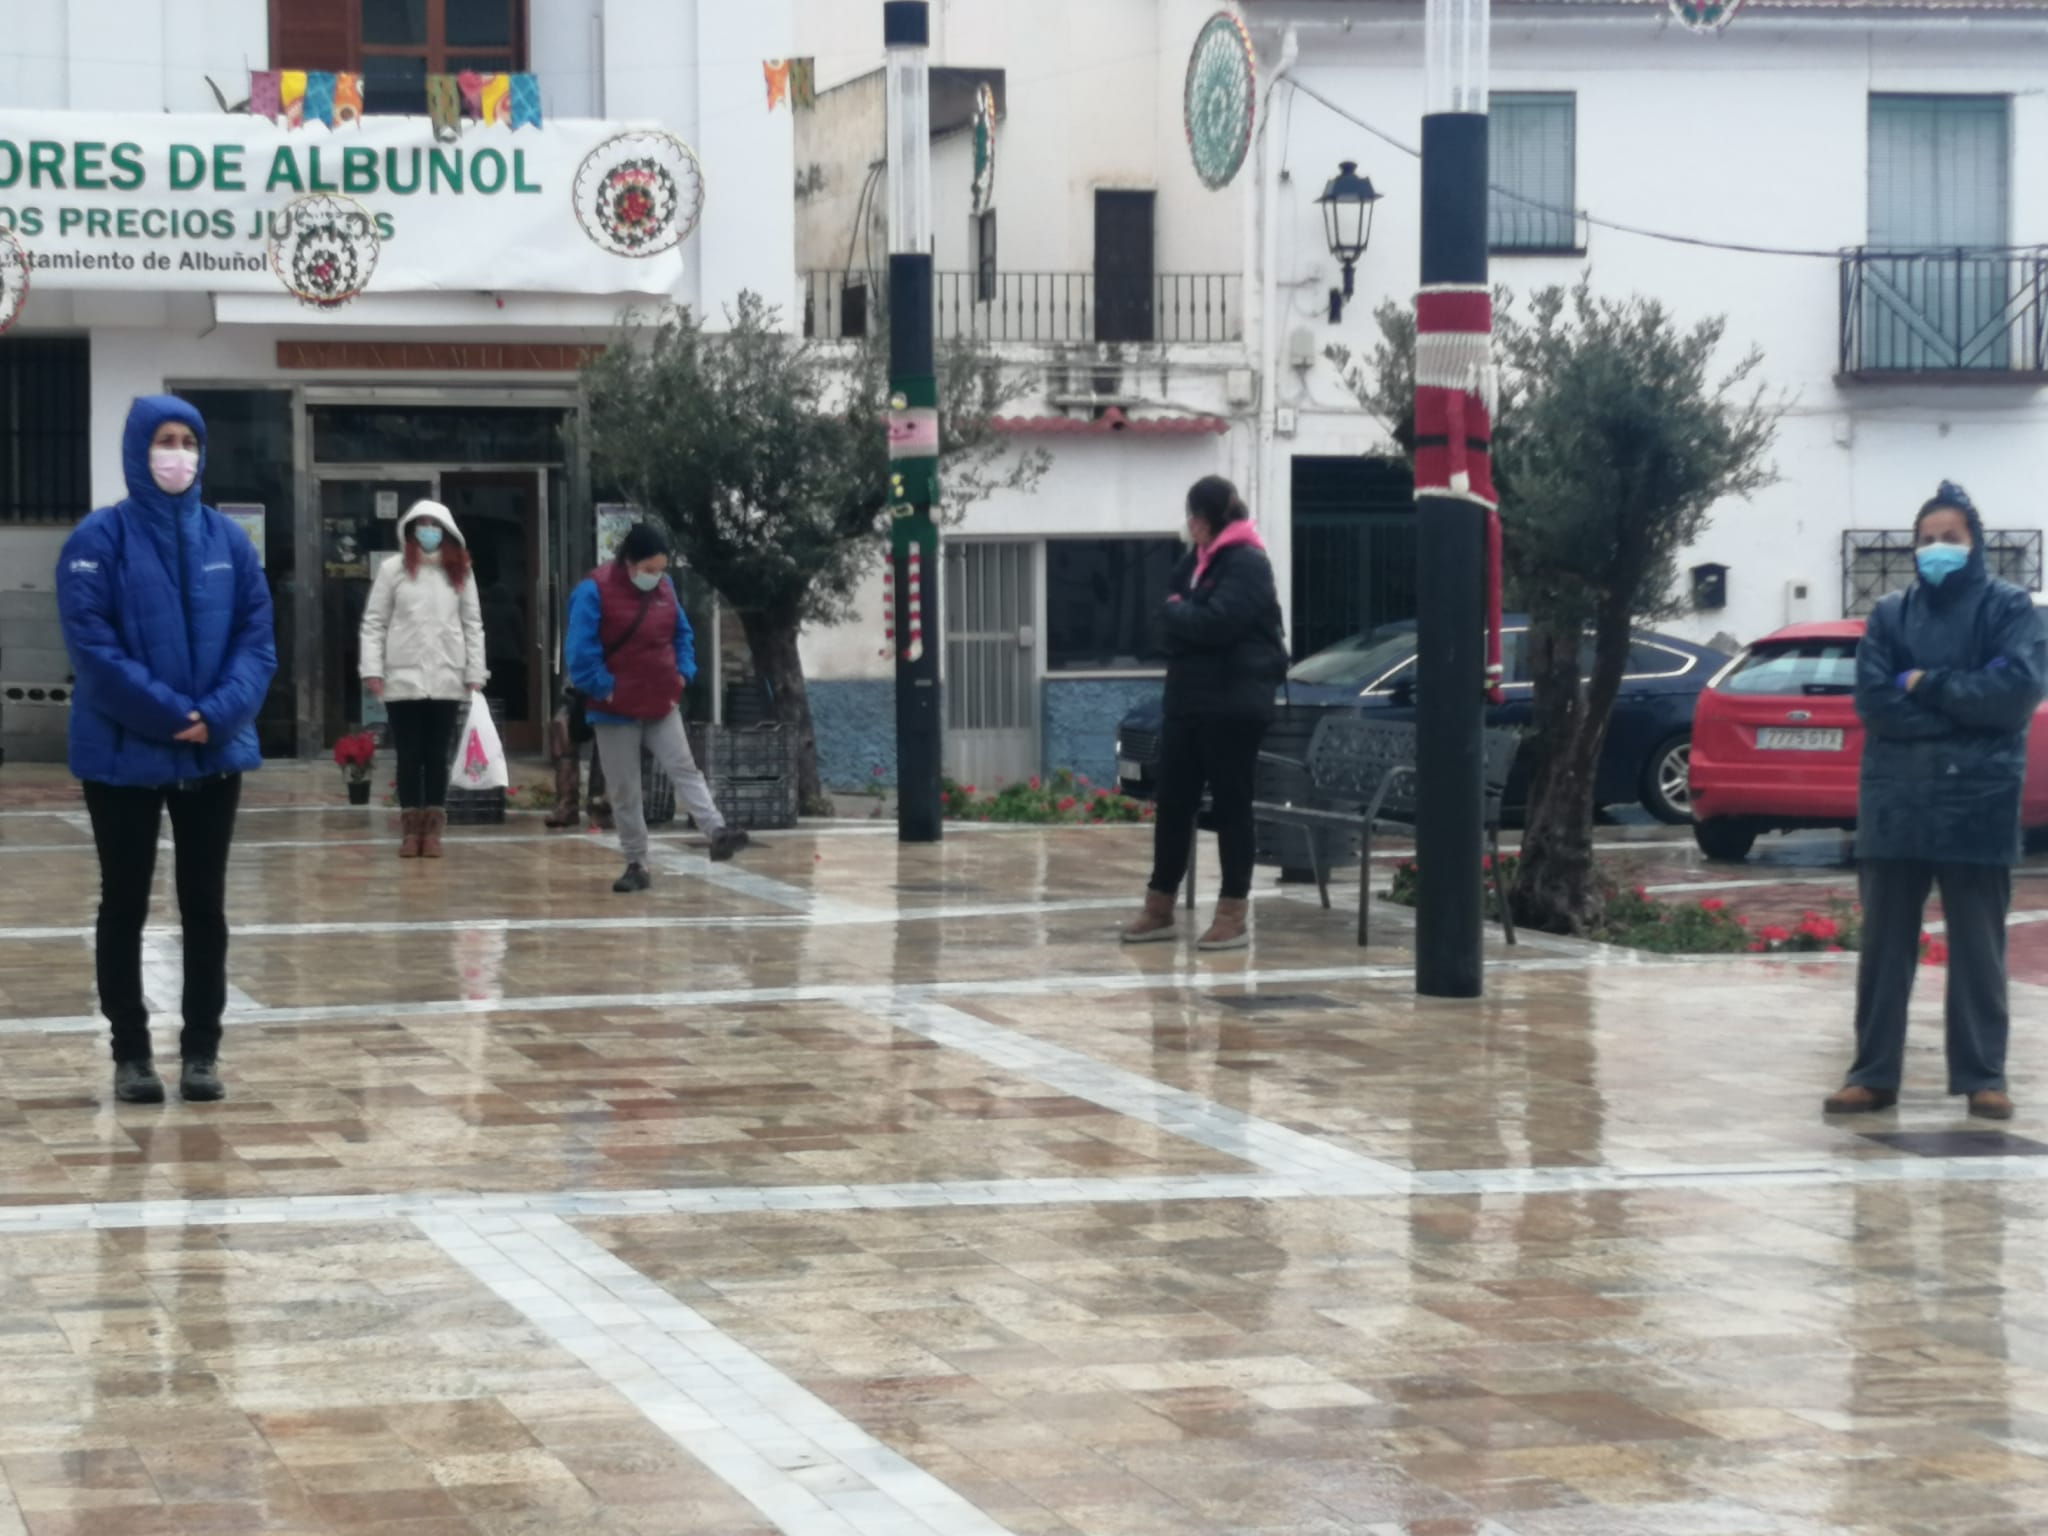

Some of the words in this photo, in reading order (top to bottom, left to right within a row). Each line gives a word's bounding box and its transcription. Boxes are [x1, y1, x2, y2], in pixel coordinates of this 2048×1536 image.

[169, 144, 246, 191] DE
[59, 207, 236, 240] PRECIOS
[143, 251, 171, 271] de
[179, 251, 267, 272] Albuñol
